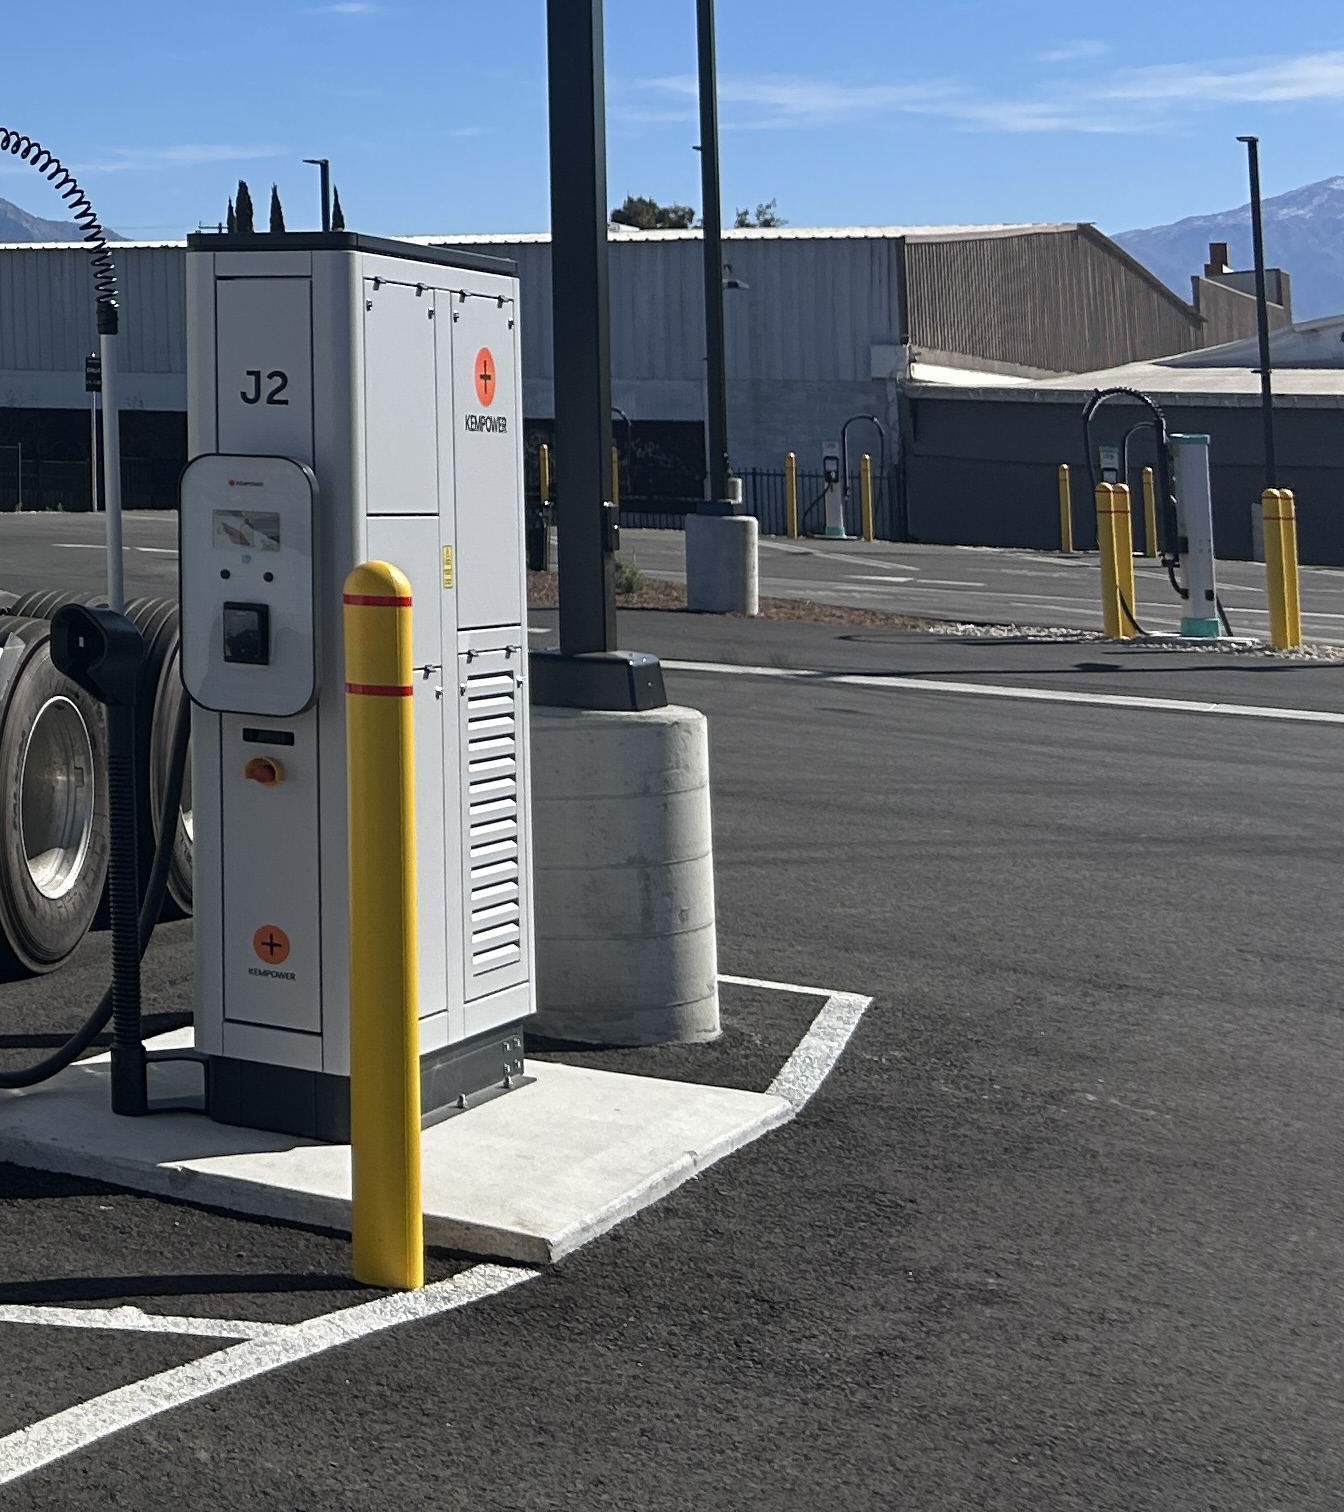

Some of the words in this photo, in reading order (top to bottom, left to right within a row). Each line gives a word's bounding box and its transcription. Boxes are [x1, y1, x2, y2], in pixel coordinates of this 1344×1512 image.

[240, 370, 289, 405] J2
[464, 413, 508, 434] KEMPOWER
[248, 967, 297, 981] KEMPOWER
